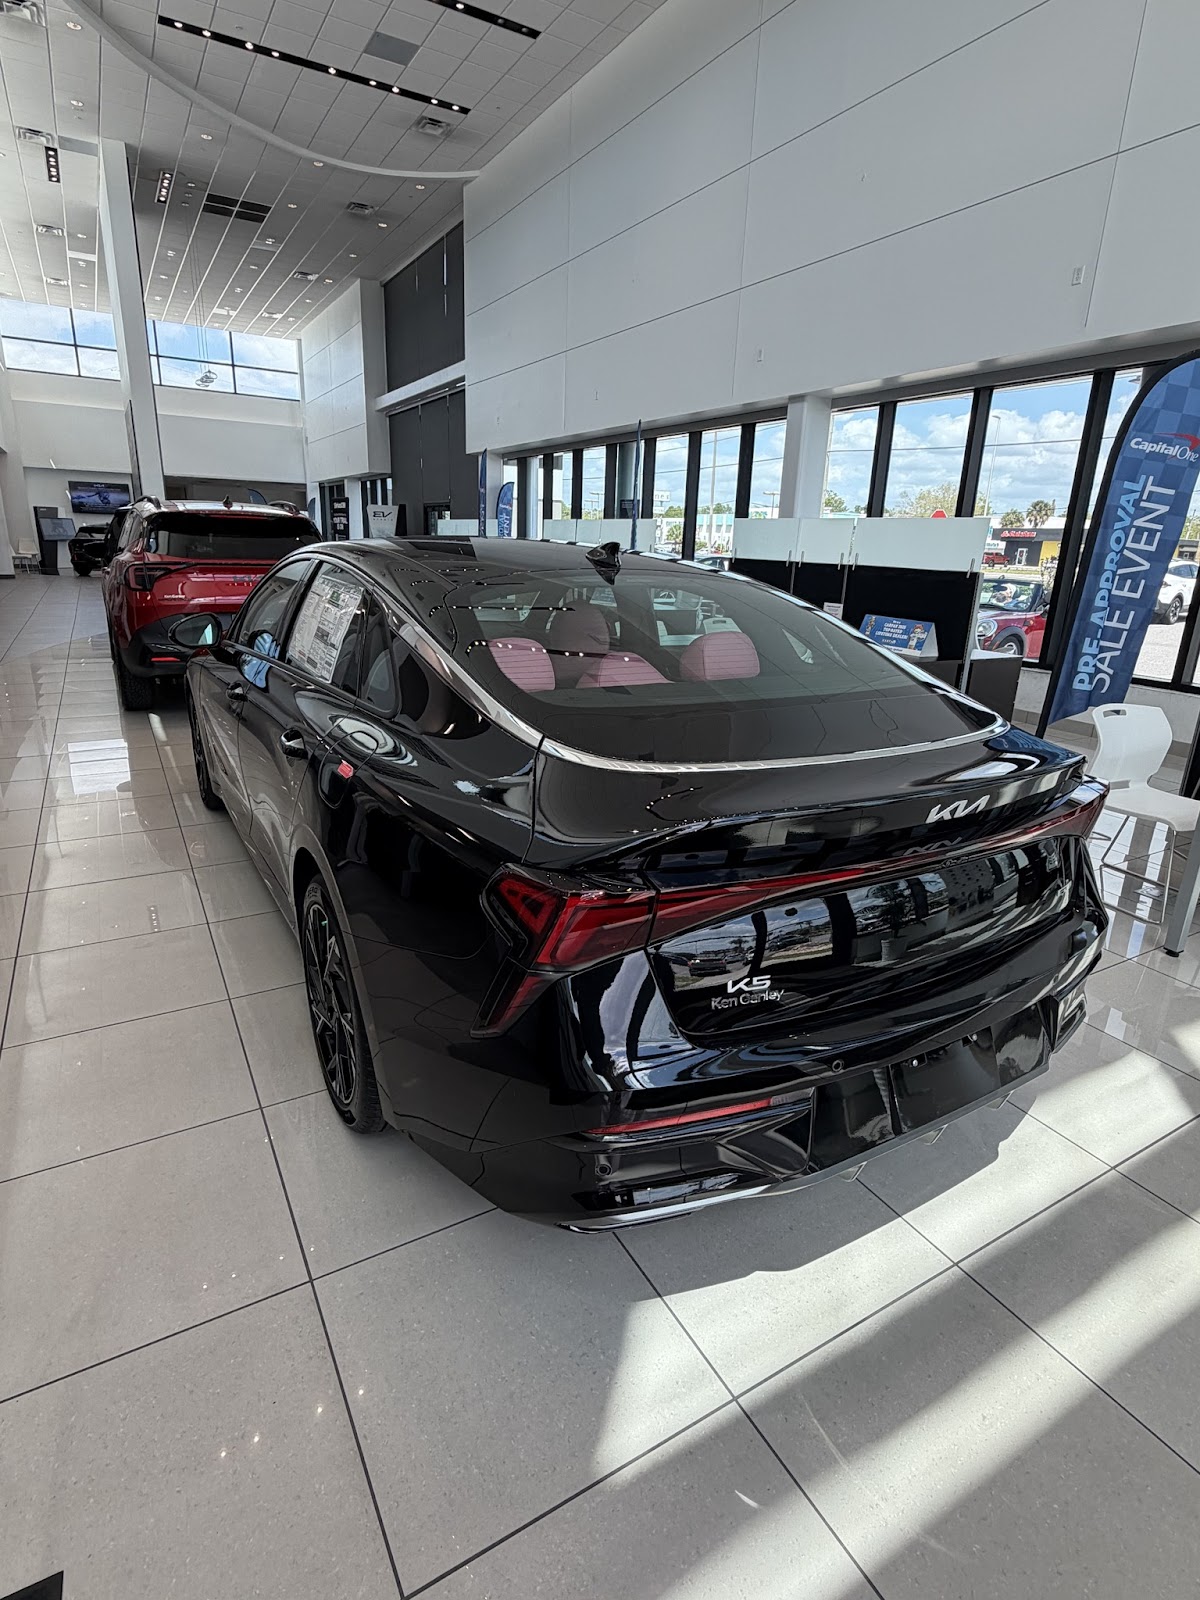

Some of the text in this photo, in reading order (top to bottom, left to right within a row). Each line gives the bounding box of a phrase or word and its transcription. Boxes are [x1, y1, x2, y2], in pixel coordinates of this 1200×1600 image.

[1072, 474, 1147, 692] PRE-APPROVAL
[1090, 475, 1176, 694] SALE EVENT
[711, 990, 785, 1010] Ken Ganley
[727, 975, 772, 993] K5
